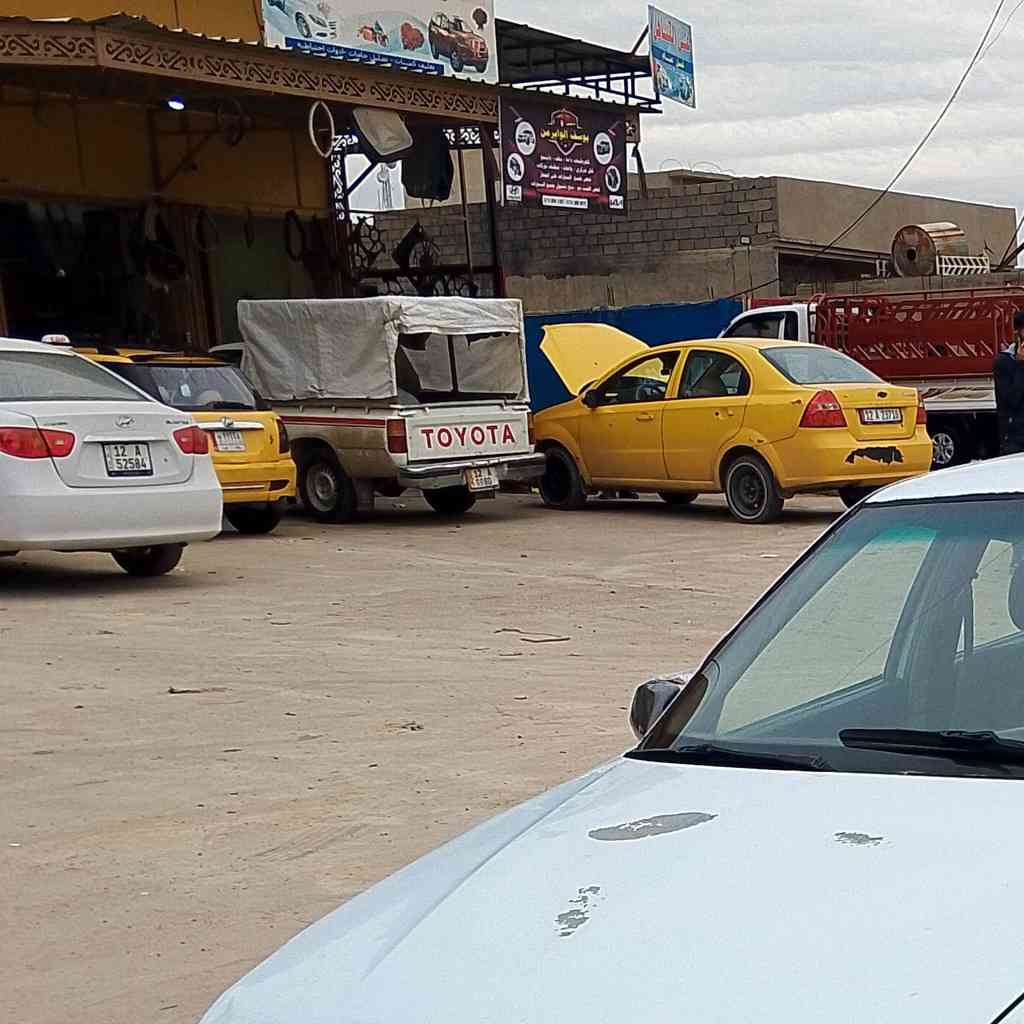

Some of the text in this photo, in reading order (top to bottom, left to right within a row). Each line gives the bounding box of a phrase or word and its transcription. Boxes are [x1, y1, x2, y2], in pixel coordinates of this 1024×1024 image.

[421, 424, 515, 448] TOYOTA
[114, 445, 142, 457] 12 A
[115, 458, 146, 470] 52584
